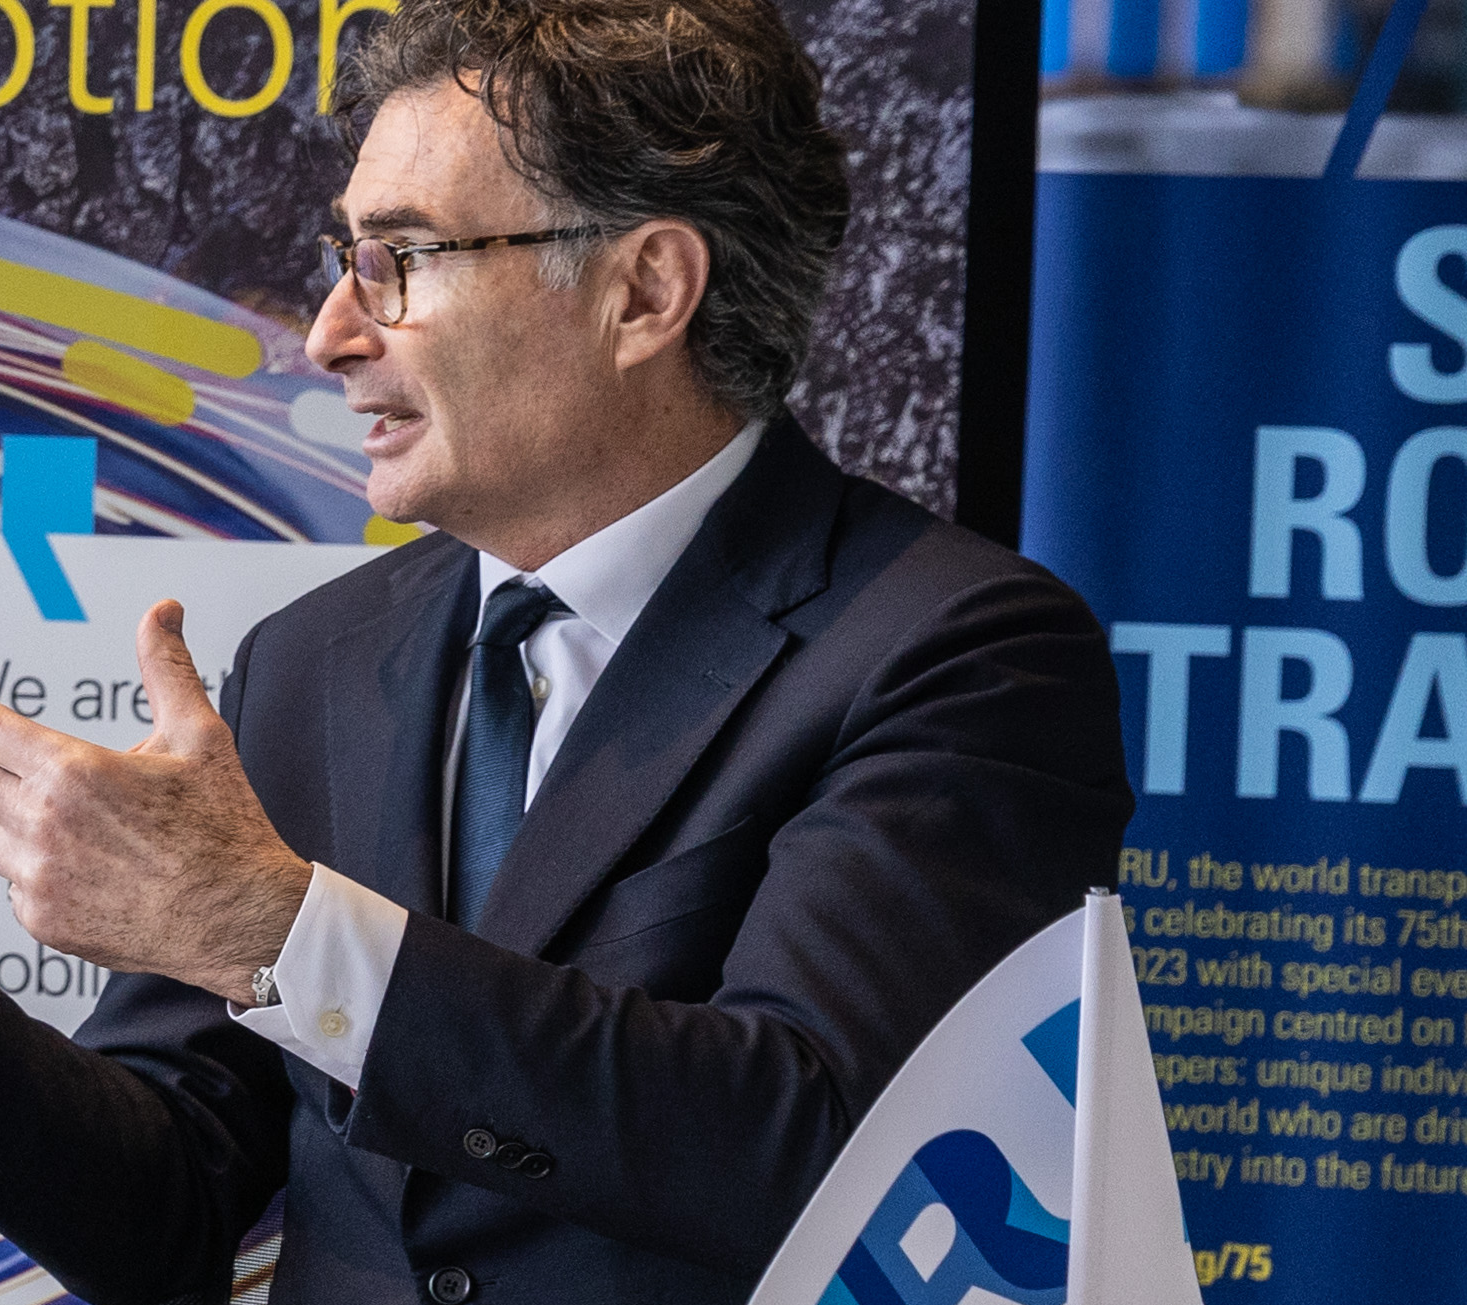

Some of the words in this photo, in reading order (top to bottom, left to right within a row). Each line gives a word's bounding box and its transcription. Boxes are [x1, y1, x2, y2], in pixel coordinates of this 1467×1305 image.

[1189, 851, 1243, 891] the
[1251, 856, 1350, 895] world
[1144, 899, 1334, 952] celebrating
[1343, 906, 1386, 946] its
[1195, 950, 1272, 989] with
[1280, 956, 1401, 999] special
[1273, 1007, 1404, 1045] centred
[1411, 1016, 1455, 1046] on
[1256, 1050, 1373, 1097] unique
[1163, 1096, 1259, 1135] world
[1267, 1100, 1341, 1140] who
[1350, 1112, 1406, 1143] are
[1241, 1144, 1307, 1187] into
[1316, 1150, 1371, 1190] the
